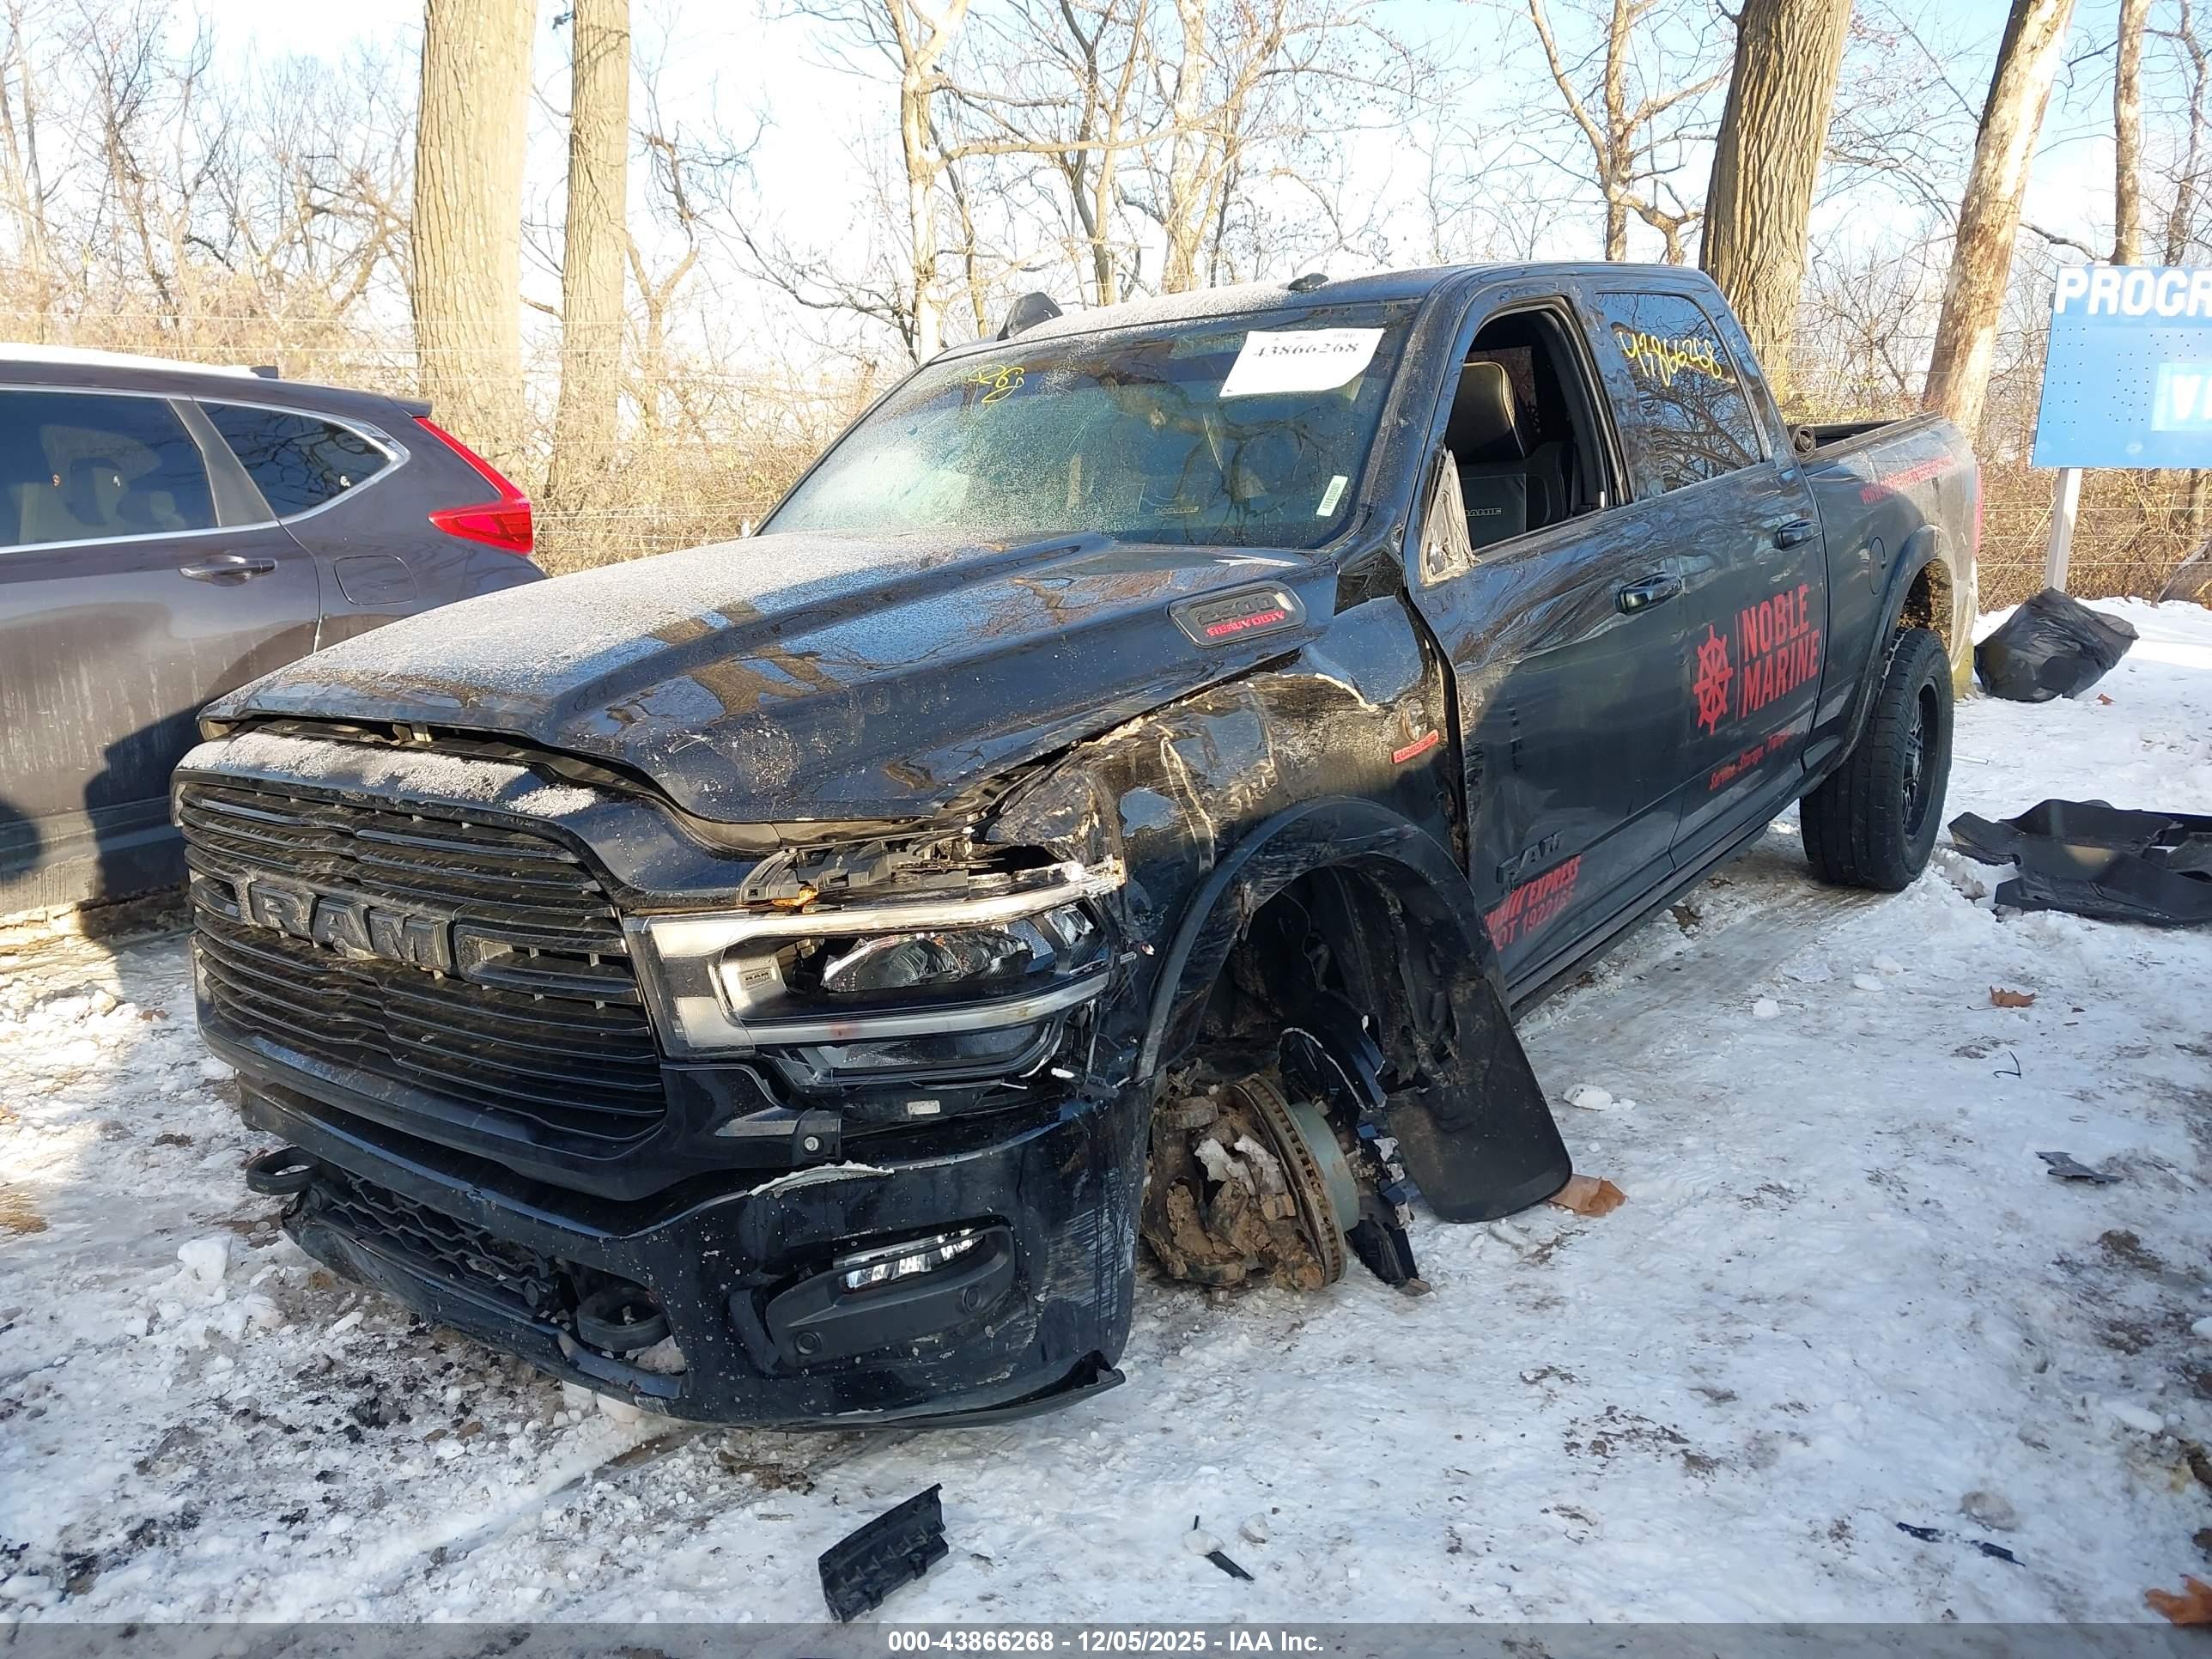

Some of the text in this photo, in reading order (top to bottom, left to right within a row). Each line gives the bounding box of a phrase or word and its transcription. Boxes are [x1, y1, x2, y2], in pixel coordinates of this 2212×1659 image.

[1742, 583, 1810, 662] NOBLE
[1741, 629, 1820, 720] MARINE
[1497, 830, 1565, 895] RAM
[1526, 855, 1582, 908] EXPRESS
[250, 879, 453, 973] RAM
